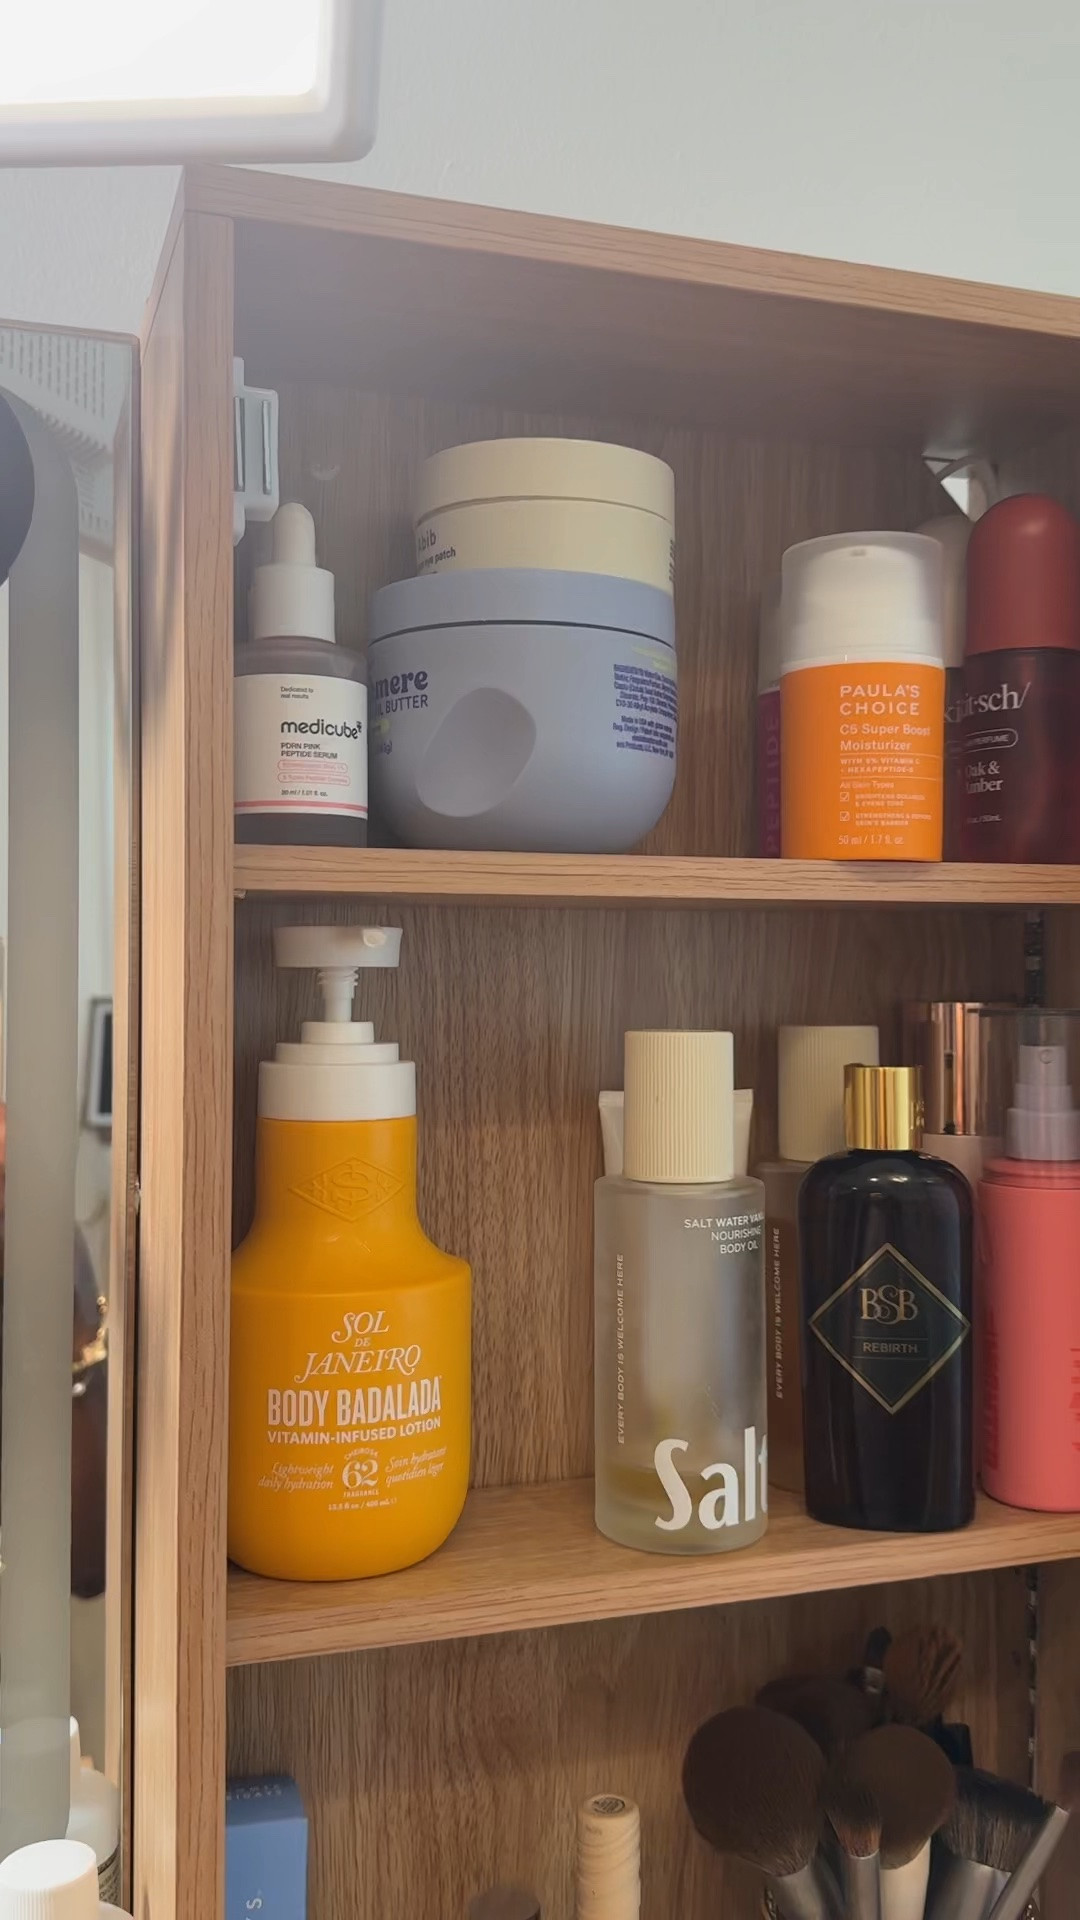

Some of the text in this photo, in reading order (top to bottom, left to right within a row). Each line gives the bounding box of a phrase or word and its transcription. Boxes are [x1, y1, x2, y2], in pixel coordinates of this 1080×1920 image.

[435, 546, 456, 565] patch
[840, 684, 920, 698] PAULA'S
[385, 694, 428, 714] BUTTER
[840, 701, 919, 715] CHOICE
[280, 718, 358, 739] medicube
[840, 723, 931, 737] C5 Super Boost
[840, 740, 912, 751] Moisturizer
[988, 760, 1000, 775] &
[839, 834, 849, 845] 50
[684, 1218, 713, 1229] SALT
[715, 1215, 749, 1227] WATER
[720, 1242, 746, 1254] BODY
[772, 1227, 781, 1257] HERE
[773, 1260, 782, 1314] WELCOME
[860, 1285, 918, 1325] BSB
[331, 1310, 390, 1344] SOL
[354, 1337, 371, 1348] DE
[616, 1254, 625, 1444] EVERY BODY IS WELCOME HERE
[863, 1341, 917, 1353] REBIRTH
[293, 1344, 421, 1384] JANEIRO
[268, 1376, 442, 1427] BODY BADALADA
[267, 1416, 441, 1445] VITAMIN-INFUSED LOTION
[272, 1461, 334, 1480] Lightweight
[342, 1459, 379, 1488] 62
[385, 1456, 409, 1473] Soin
[258, 1475, 334, 1493] daily hydration
[343, 1490, 380, 1498] FRAGRANCE
